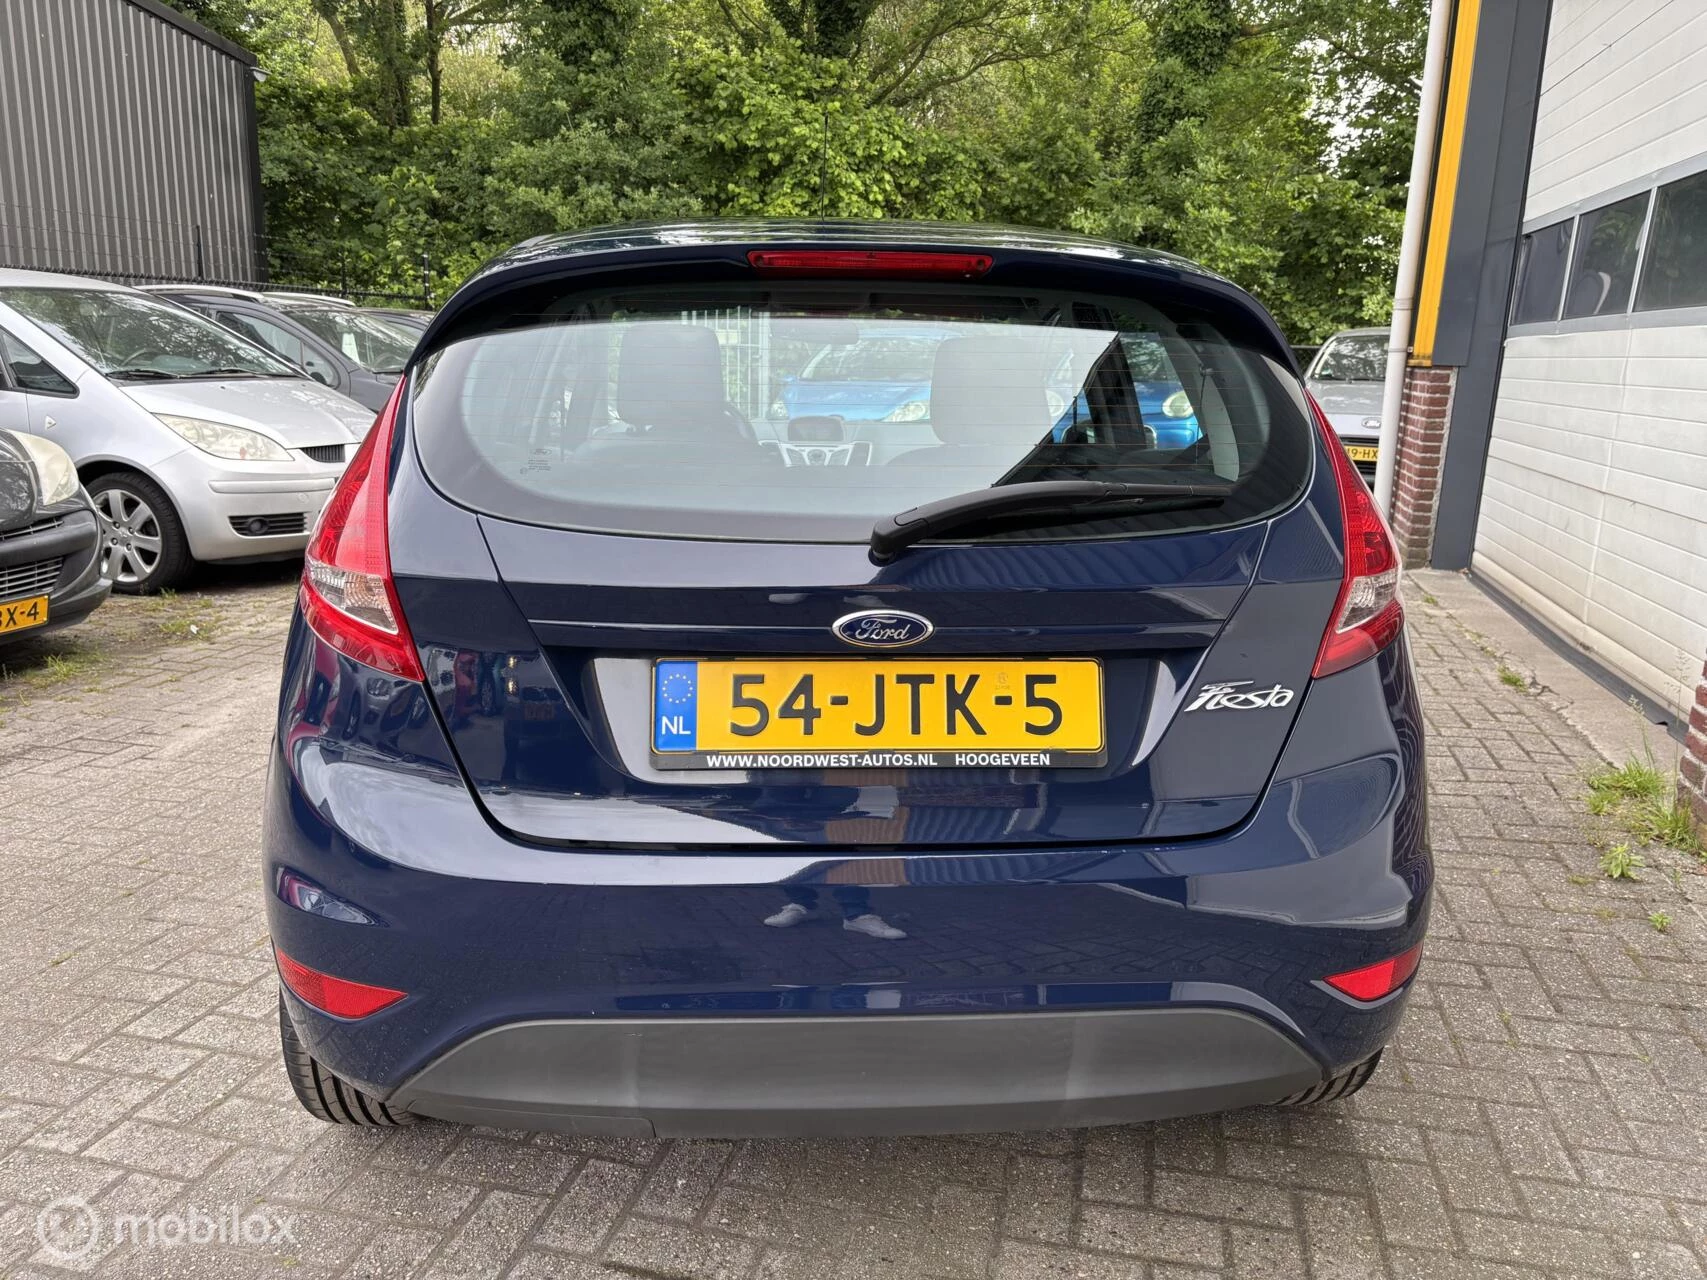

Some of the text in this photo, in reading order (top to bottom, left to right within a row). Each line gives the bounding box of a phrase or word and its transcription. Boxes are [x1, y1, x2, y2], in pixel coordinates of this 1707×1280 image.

[0, 601, 40, 628] X-4
[855, 618, 911, 640] Ford
[730, 673, 1063, 737] 54-JTK-5
[1184, 680, 1294, 712] Fiesta
[661, 716, 691, 735] NL
[706, 753, 1051, 768] WWW.NOORDWEST-AUTOS.NL HOOGEVEEN
